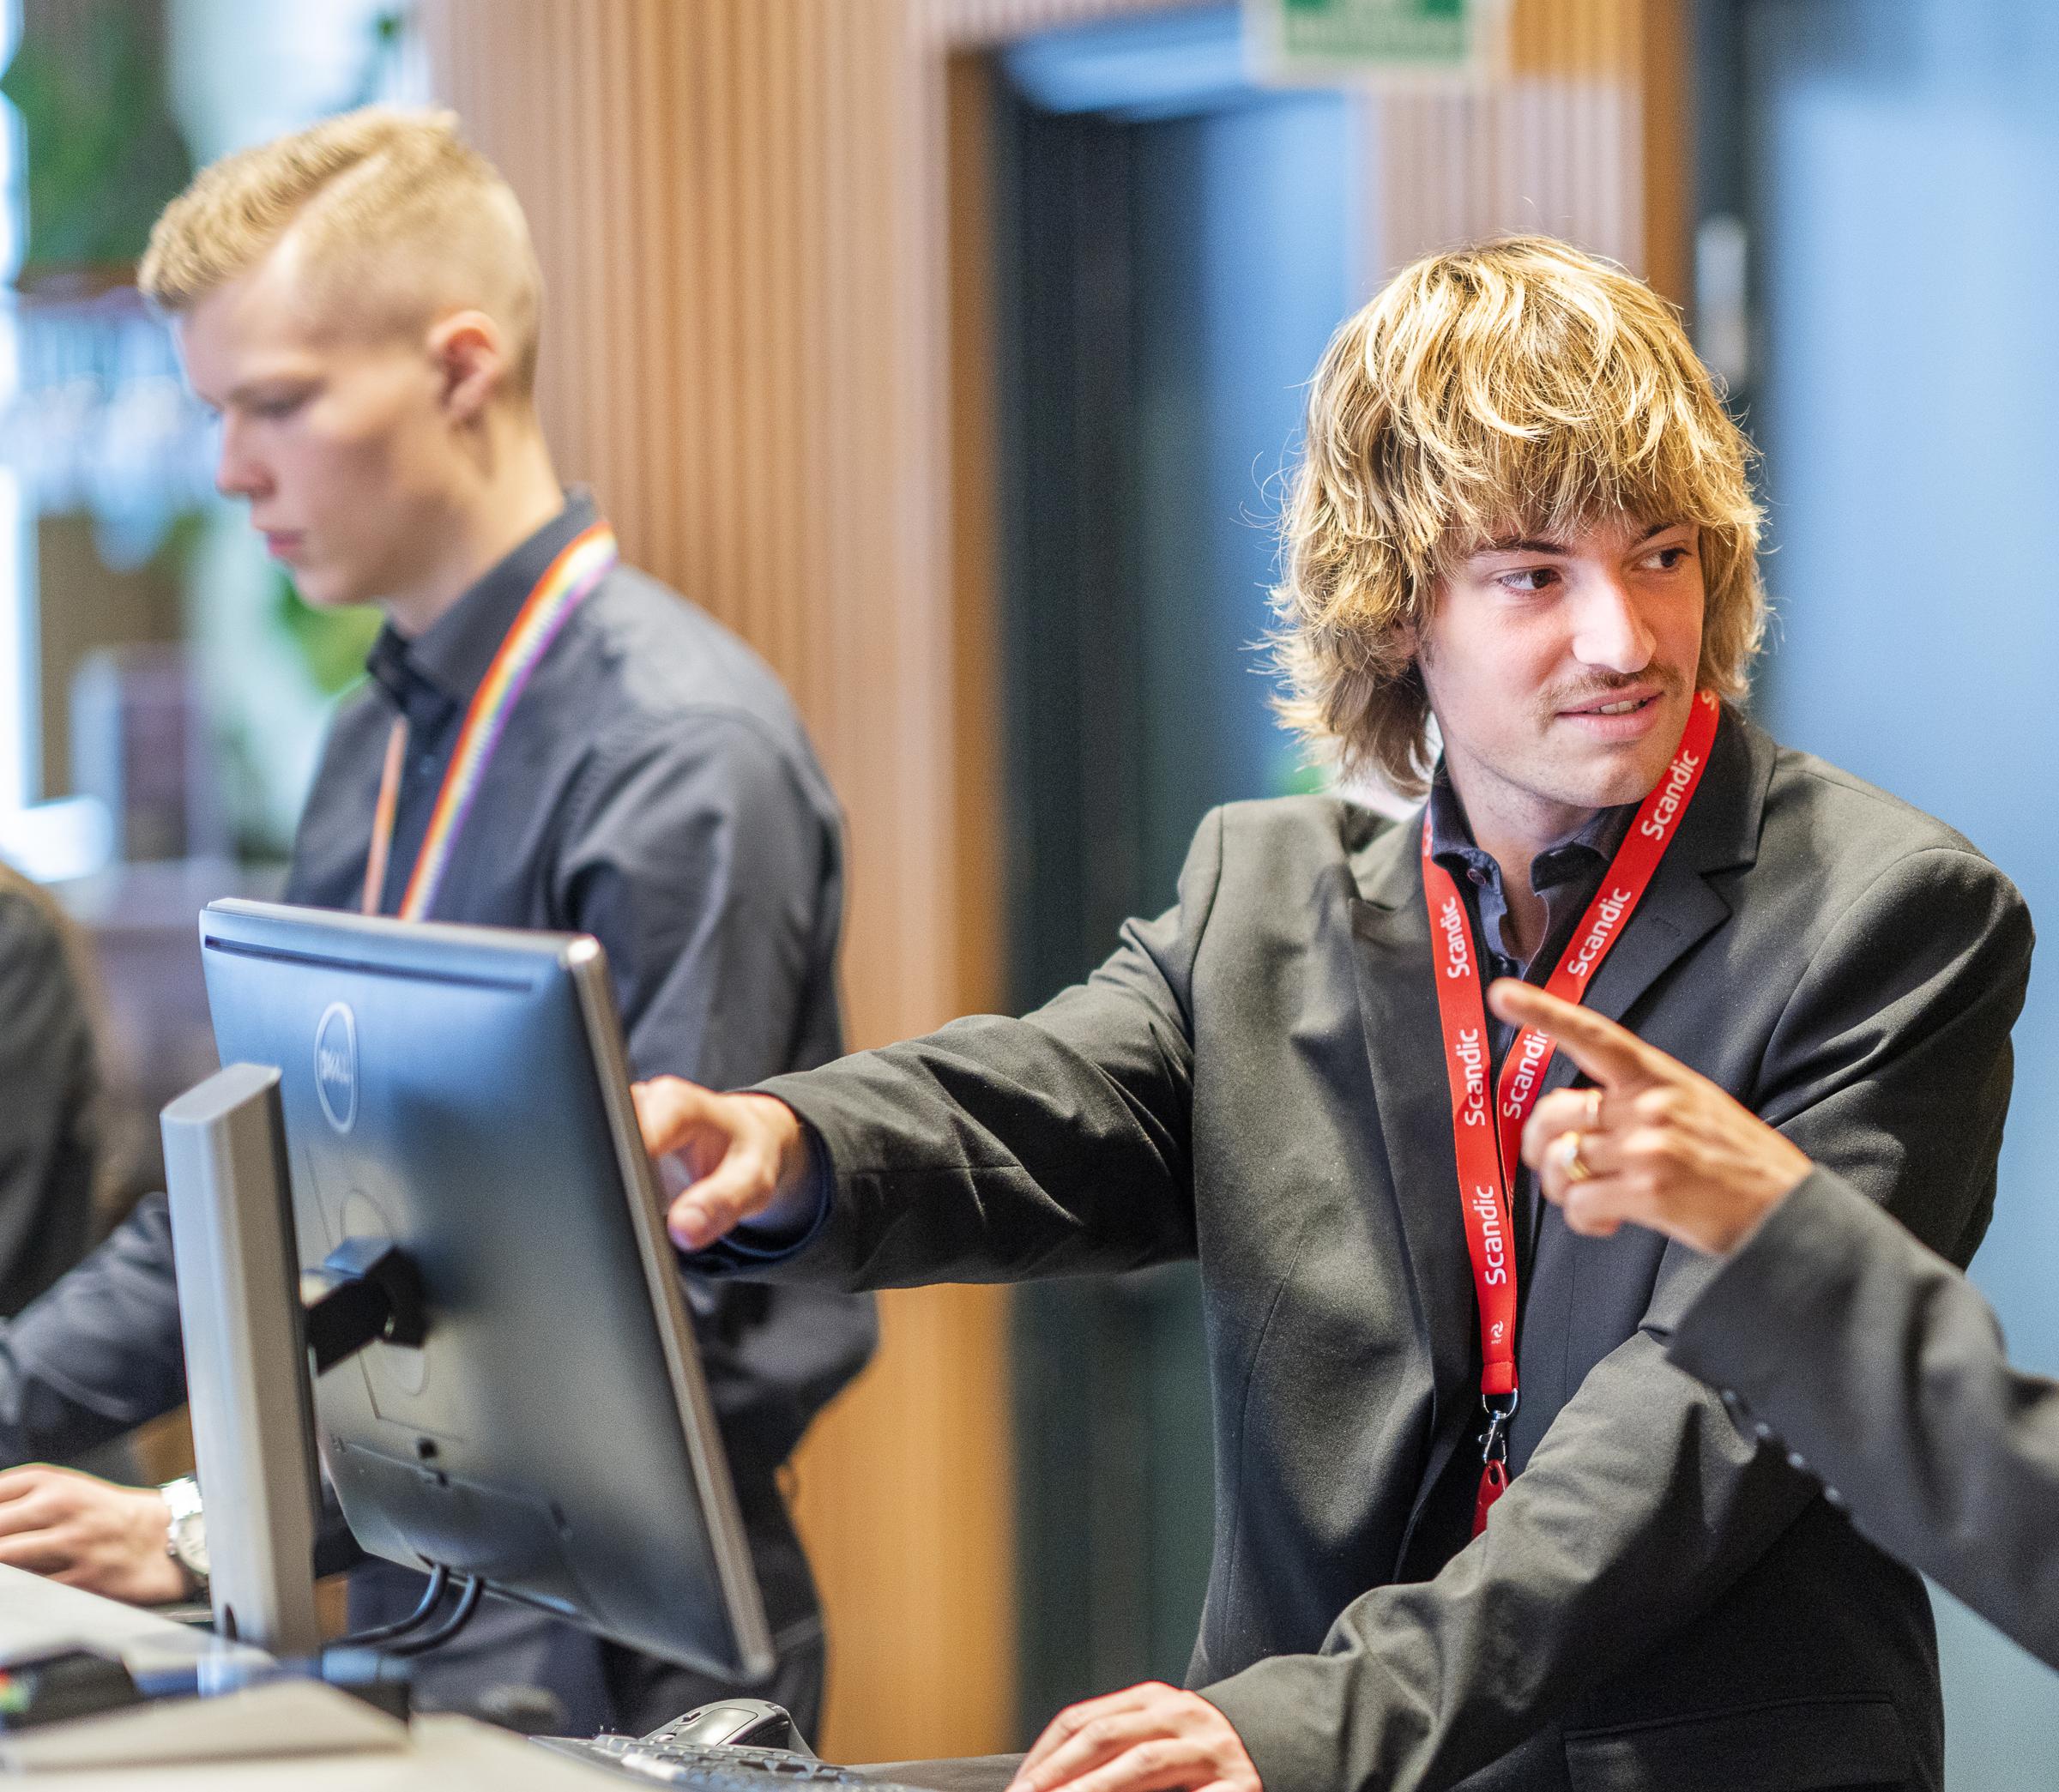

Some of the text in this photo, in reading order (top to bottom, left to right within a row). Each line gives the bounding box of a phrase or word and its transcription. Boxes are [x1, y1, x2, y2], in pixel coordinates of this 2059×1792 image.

[1641, 749, 1700, 841] Scandic
[1440, 896, 1470, 980] Scandic
[1567, 887, 1632, 977] Scandic
[1455, 1028, 1486, 1126] Scandic
[1472, 1185, 1507, 1286] Scandic
